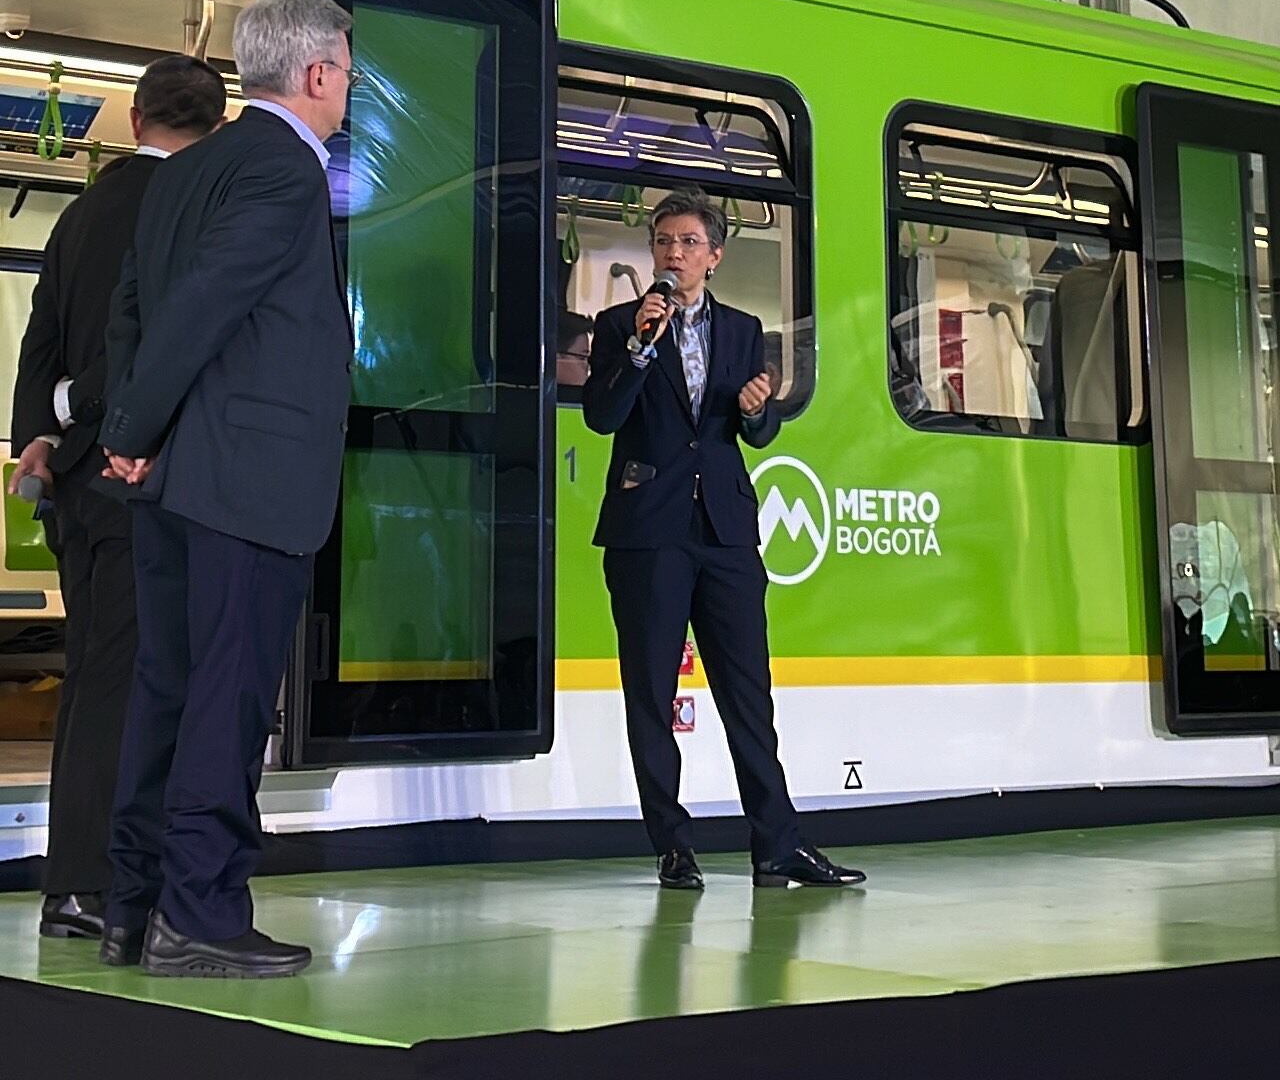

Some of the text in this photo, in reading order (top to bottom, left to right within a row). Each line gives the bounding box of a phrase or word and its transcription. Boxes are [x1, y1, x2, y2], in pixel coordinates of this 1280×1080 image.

[564, 446, 576, 482] 1
[835, 487, 940, 524] METRO
[836, 523, 942, 556] BOGOTÁ
